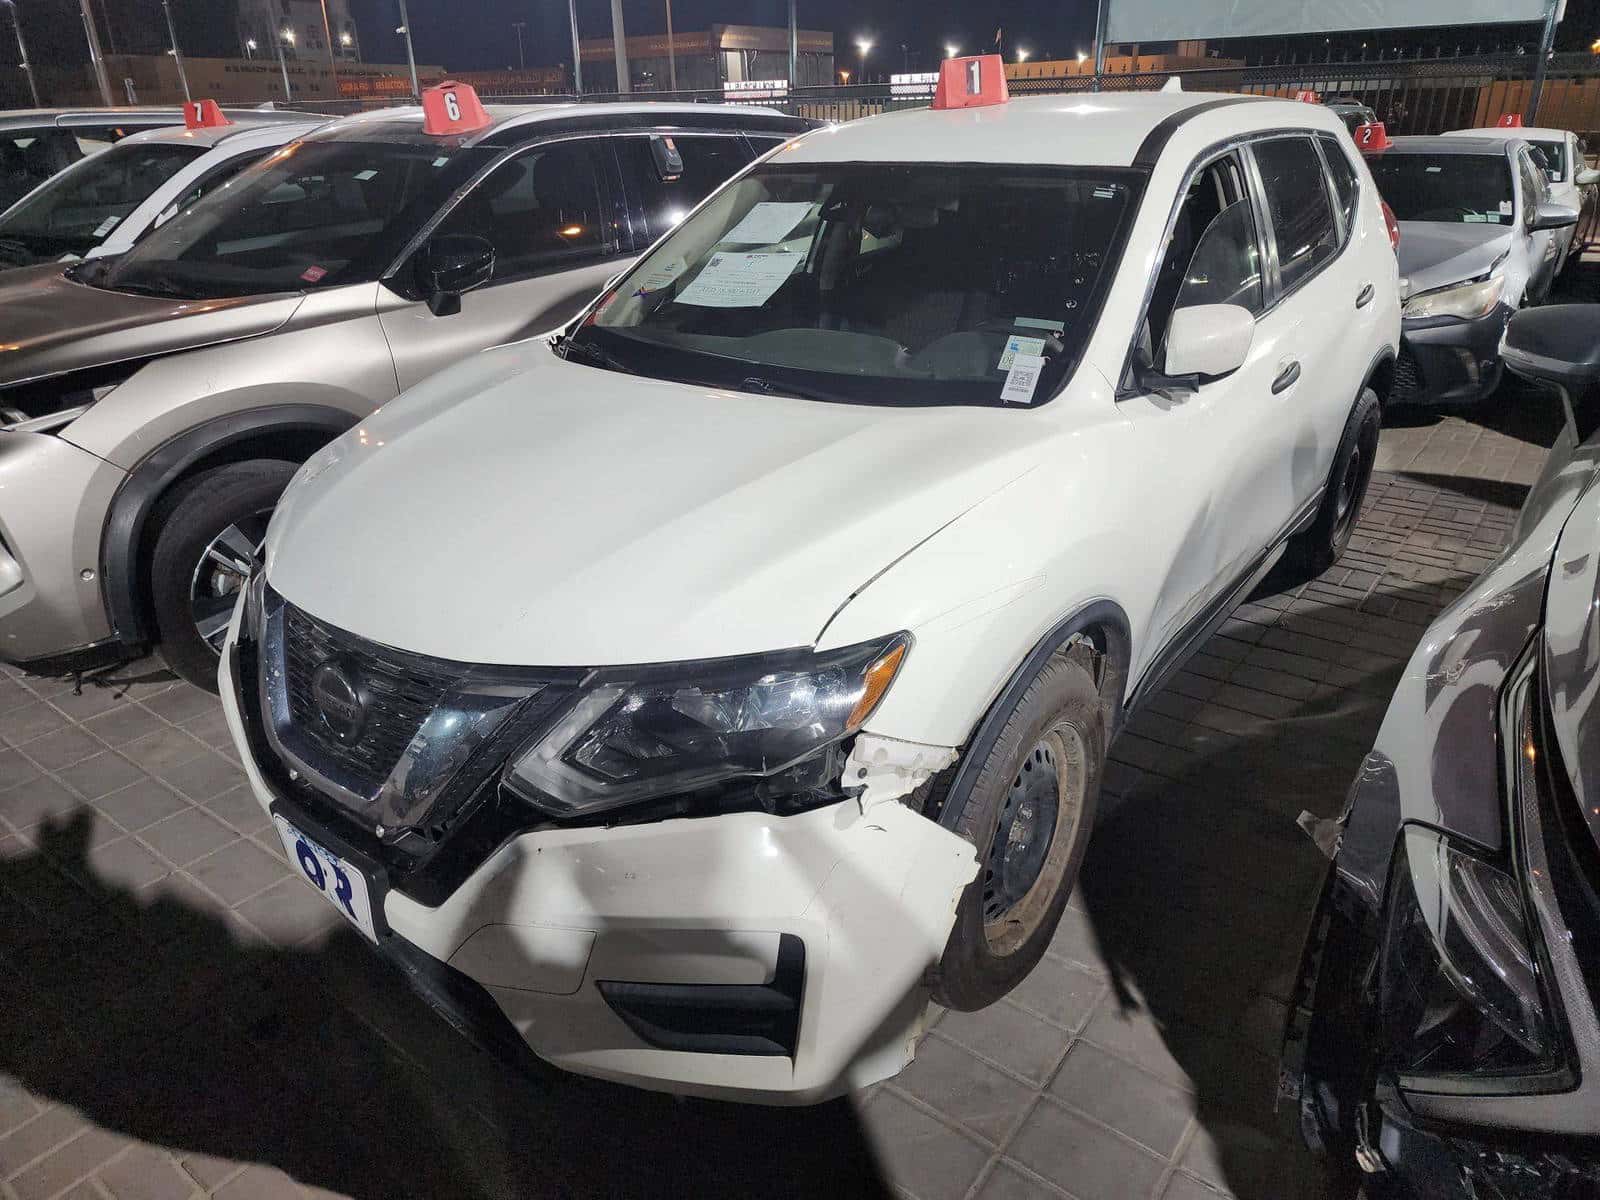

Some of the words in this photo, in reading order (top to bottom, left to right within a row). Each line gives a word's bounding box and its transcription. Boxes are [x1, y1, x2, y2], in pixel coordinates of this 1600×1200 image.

[969, 60, 981, 95] 1
[193, 102, 203, 122] 7
[444, 92, 461, 121] 6
[1506, 115, 1513, 125] 3
[1362, 128, 1372, 144] 2
